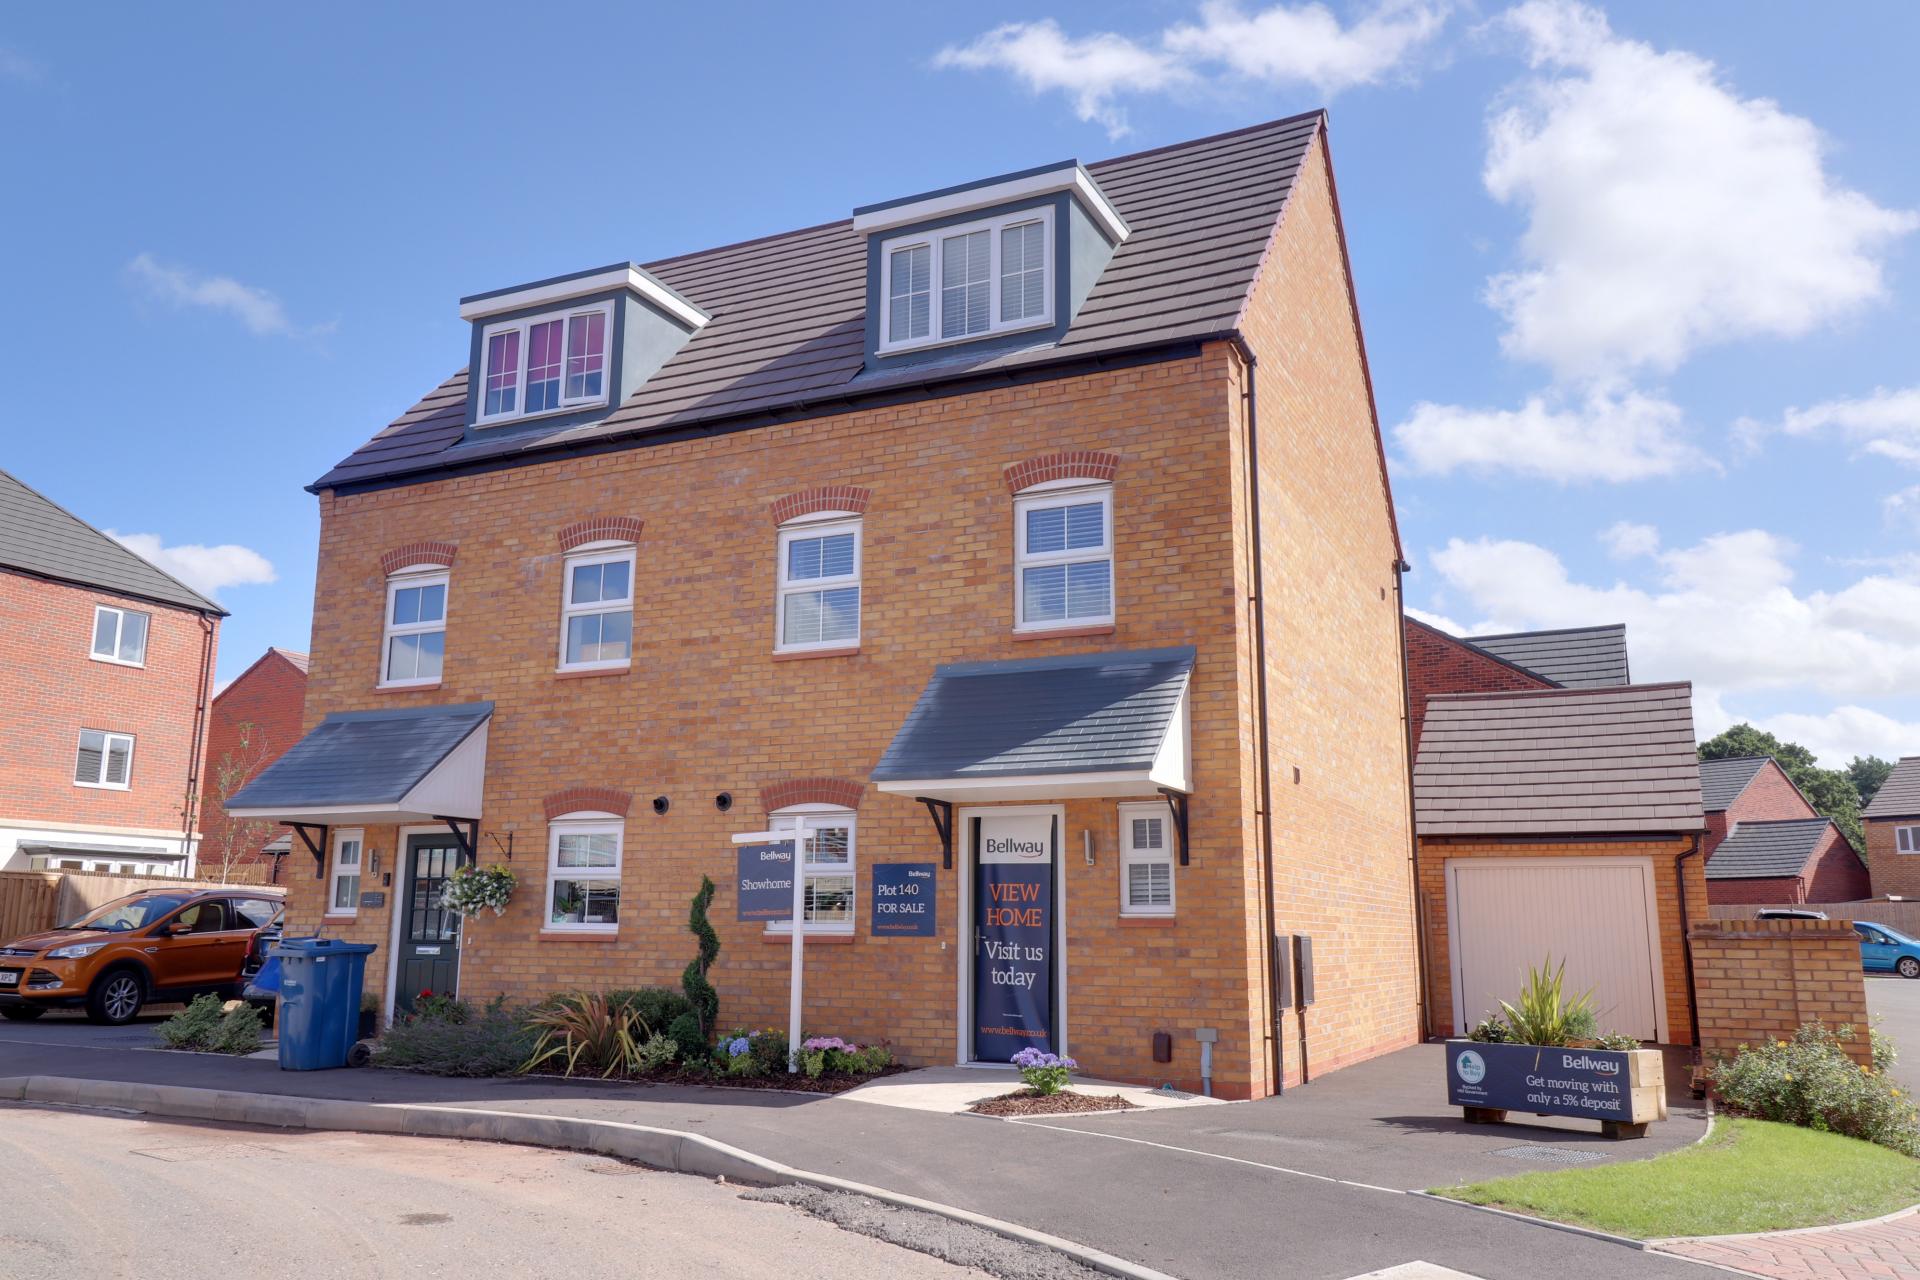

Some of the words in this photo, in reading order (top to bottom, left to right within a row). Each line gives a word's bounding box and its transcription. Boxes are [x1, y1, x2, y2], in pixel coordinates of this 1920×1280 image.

[760, 851, 792, 863] Bellway
[986, 838, 1044, 857] Bellway
[908, 870, 931, 878] Bellway
[741, 879, 792, 890] Showhome
[877, 884, 897, 896] Plot
[899, 884, 919, 895] 140
[989, 883, 1041, 902] VIEW
[877, 903, 898, 913] FOR
[899, 903, 925, 913] SALE
[986, 907, 1042, 927] HOME
[984, 941, 1020, 960] Visit
[1024, 946, 1043, 961] us
[991, 966, 1036, 990] today
[1562, 1054, 1619, 1076] Bellway
[1526, 1075, 1546, 1088] Get
[1547, 1078, 1590, 1094] moving
[1591, 1080, 1619, 1094] with
[1527, 1092, 1551, 1106] only
[1553, 1096, 1560, 1105] a
[1562, 1094, 1579, 1107] 5%
